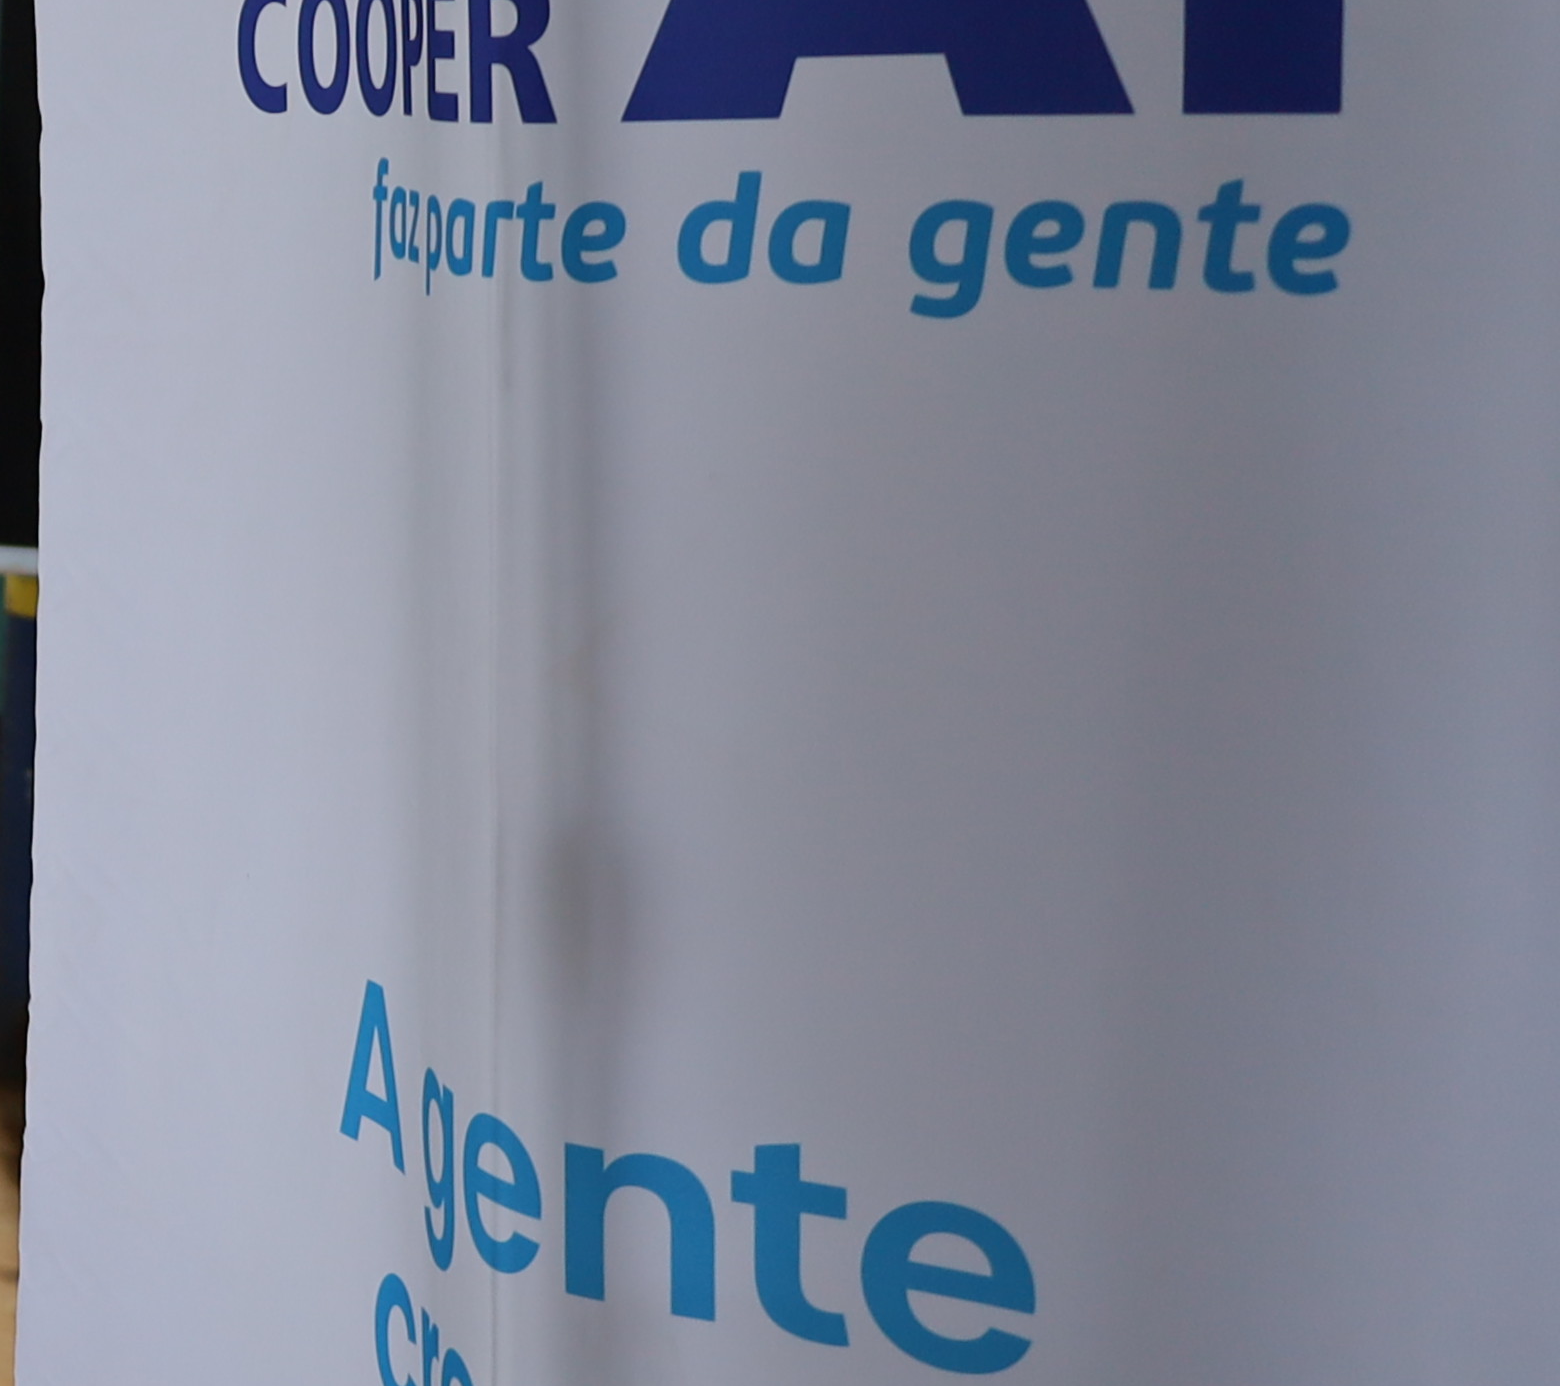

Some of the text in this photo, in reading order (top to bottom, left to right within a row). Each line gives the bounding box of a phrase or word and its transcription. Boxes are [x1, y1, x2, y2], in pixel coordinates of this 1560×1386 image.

[372, 157, 1353, 320] faz parte da gente
[339, 979, 1038, 1377] A gente
